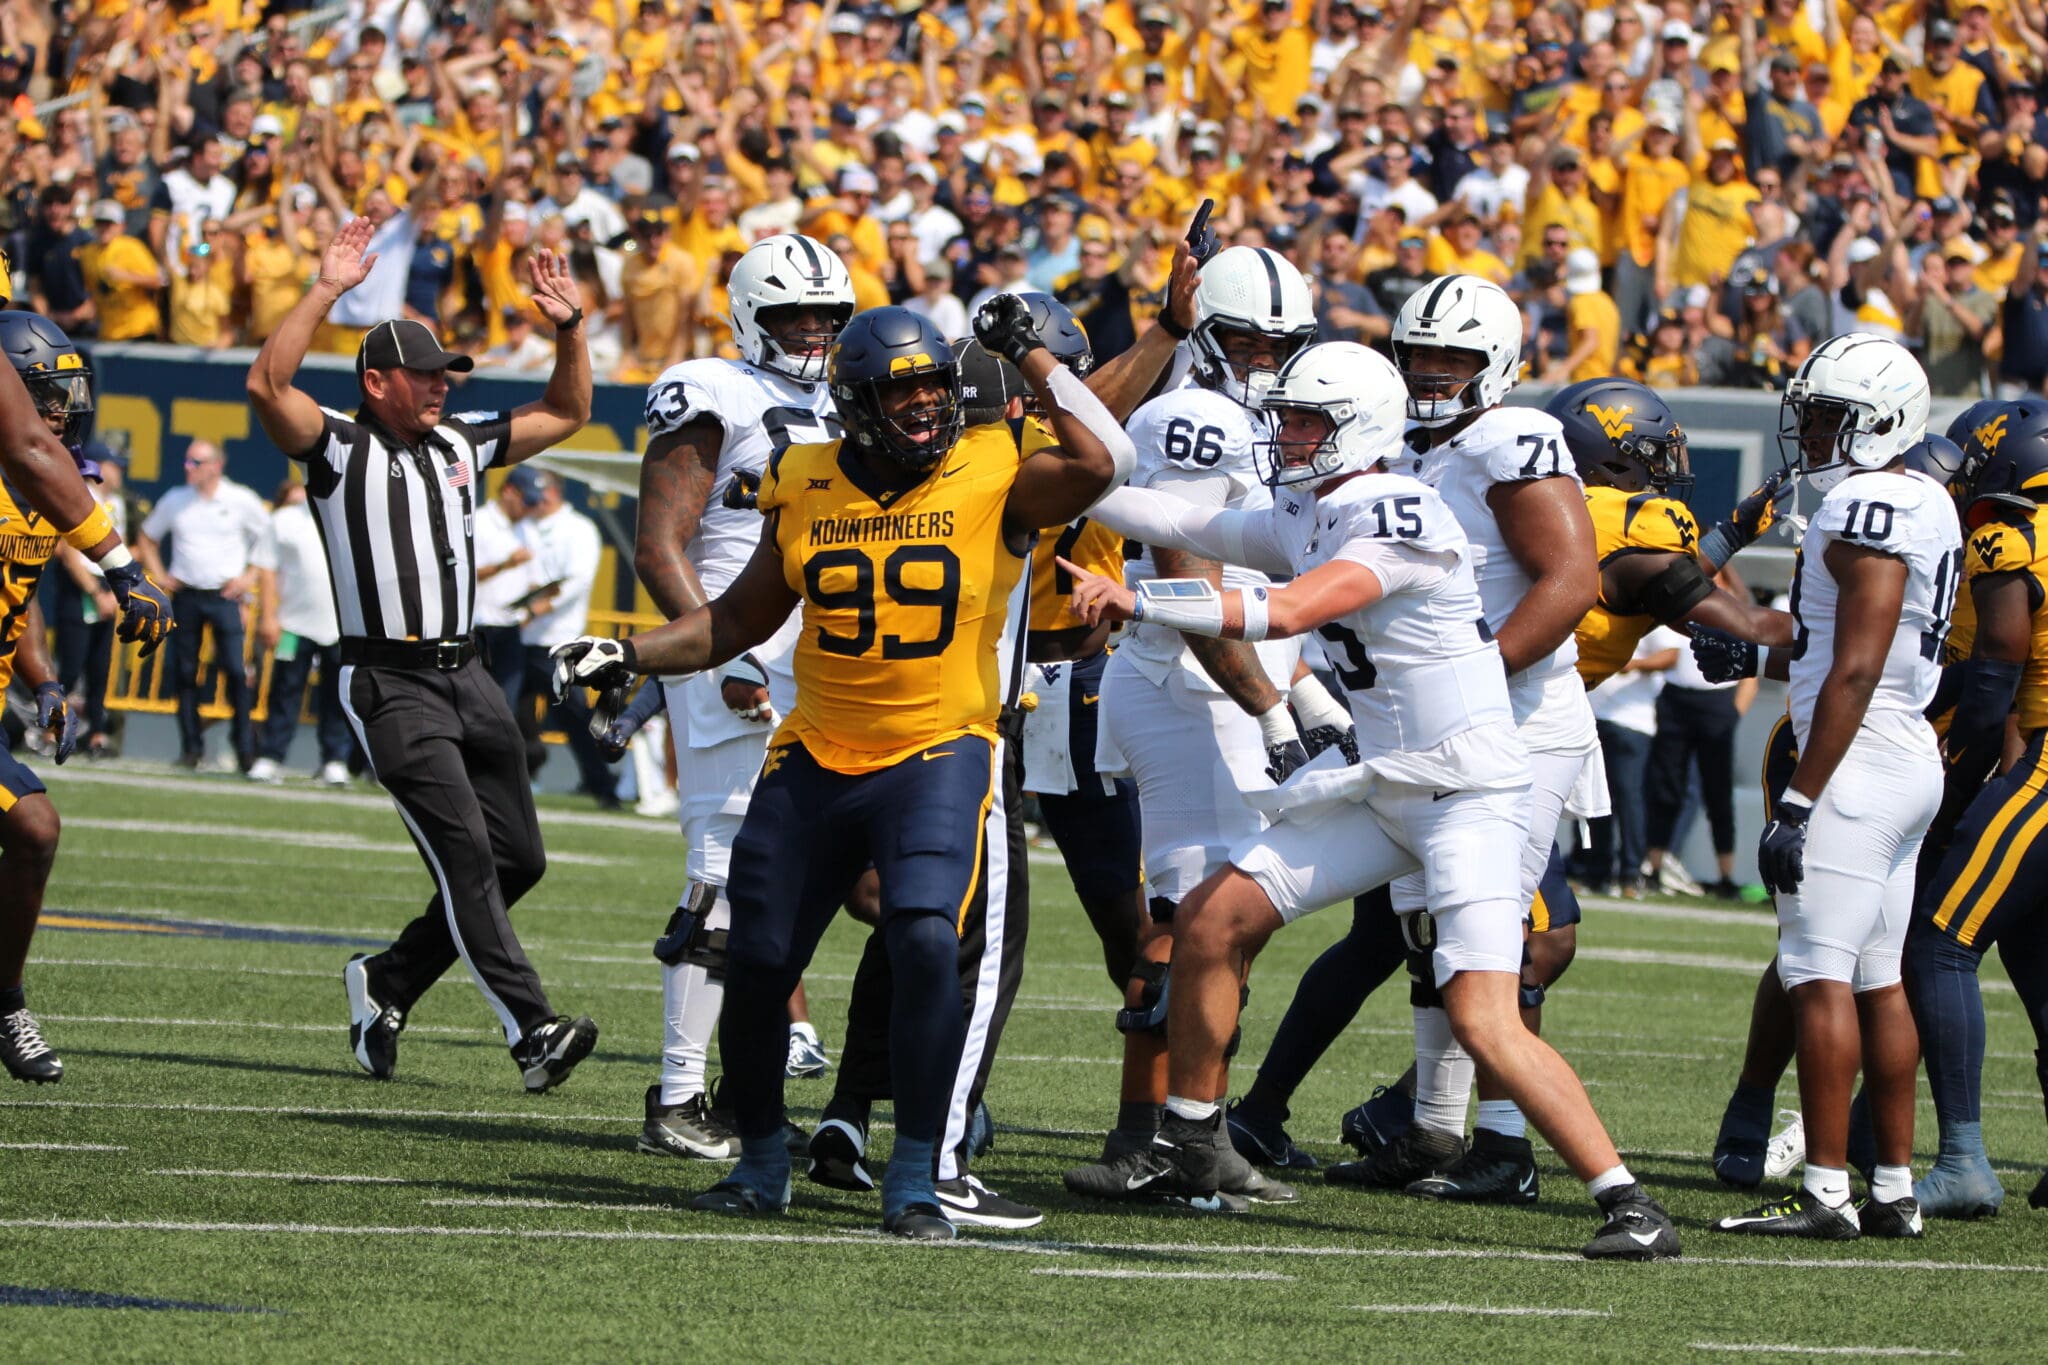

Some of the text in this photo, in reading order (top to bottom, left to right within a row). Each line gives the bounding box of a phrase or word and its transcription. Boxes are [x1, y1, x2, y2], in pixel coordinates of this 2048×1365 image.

[962, 386, 977, 398] RR
[1165, 417, 1226, 467] 66
[1516, 435, 1560, 477] 71
[463, 513, 473, 538] U
[809, 510, 954, 547] MOUNTAINEERS
[1371, 496, 1423, 539] 15
[1840, 500, 1895, 541] 10
[803, 544, 961, 661] 99
